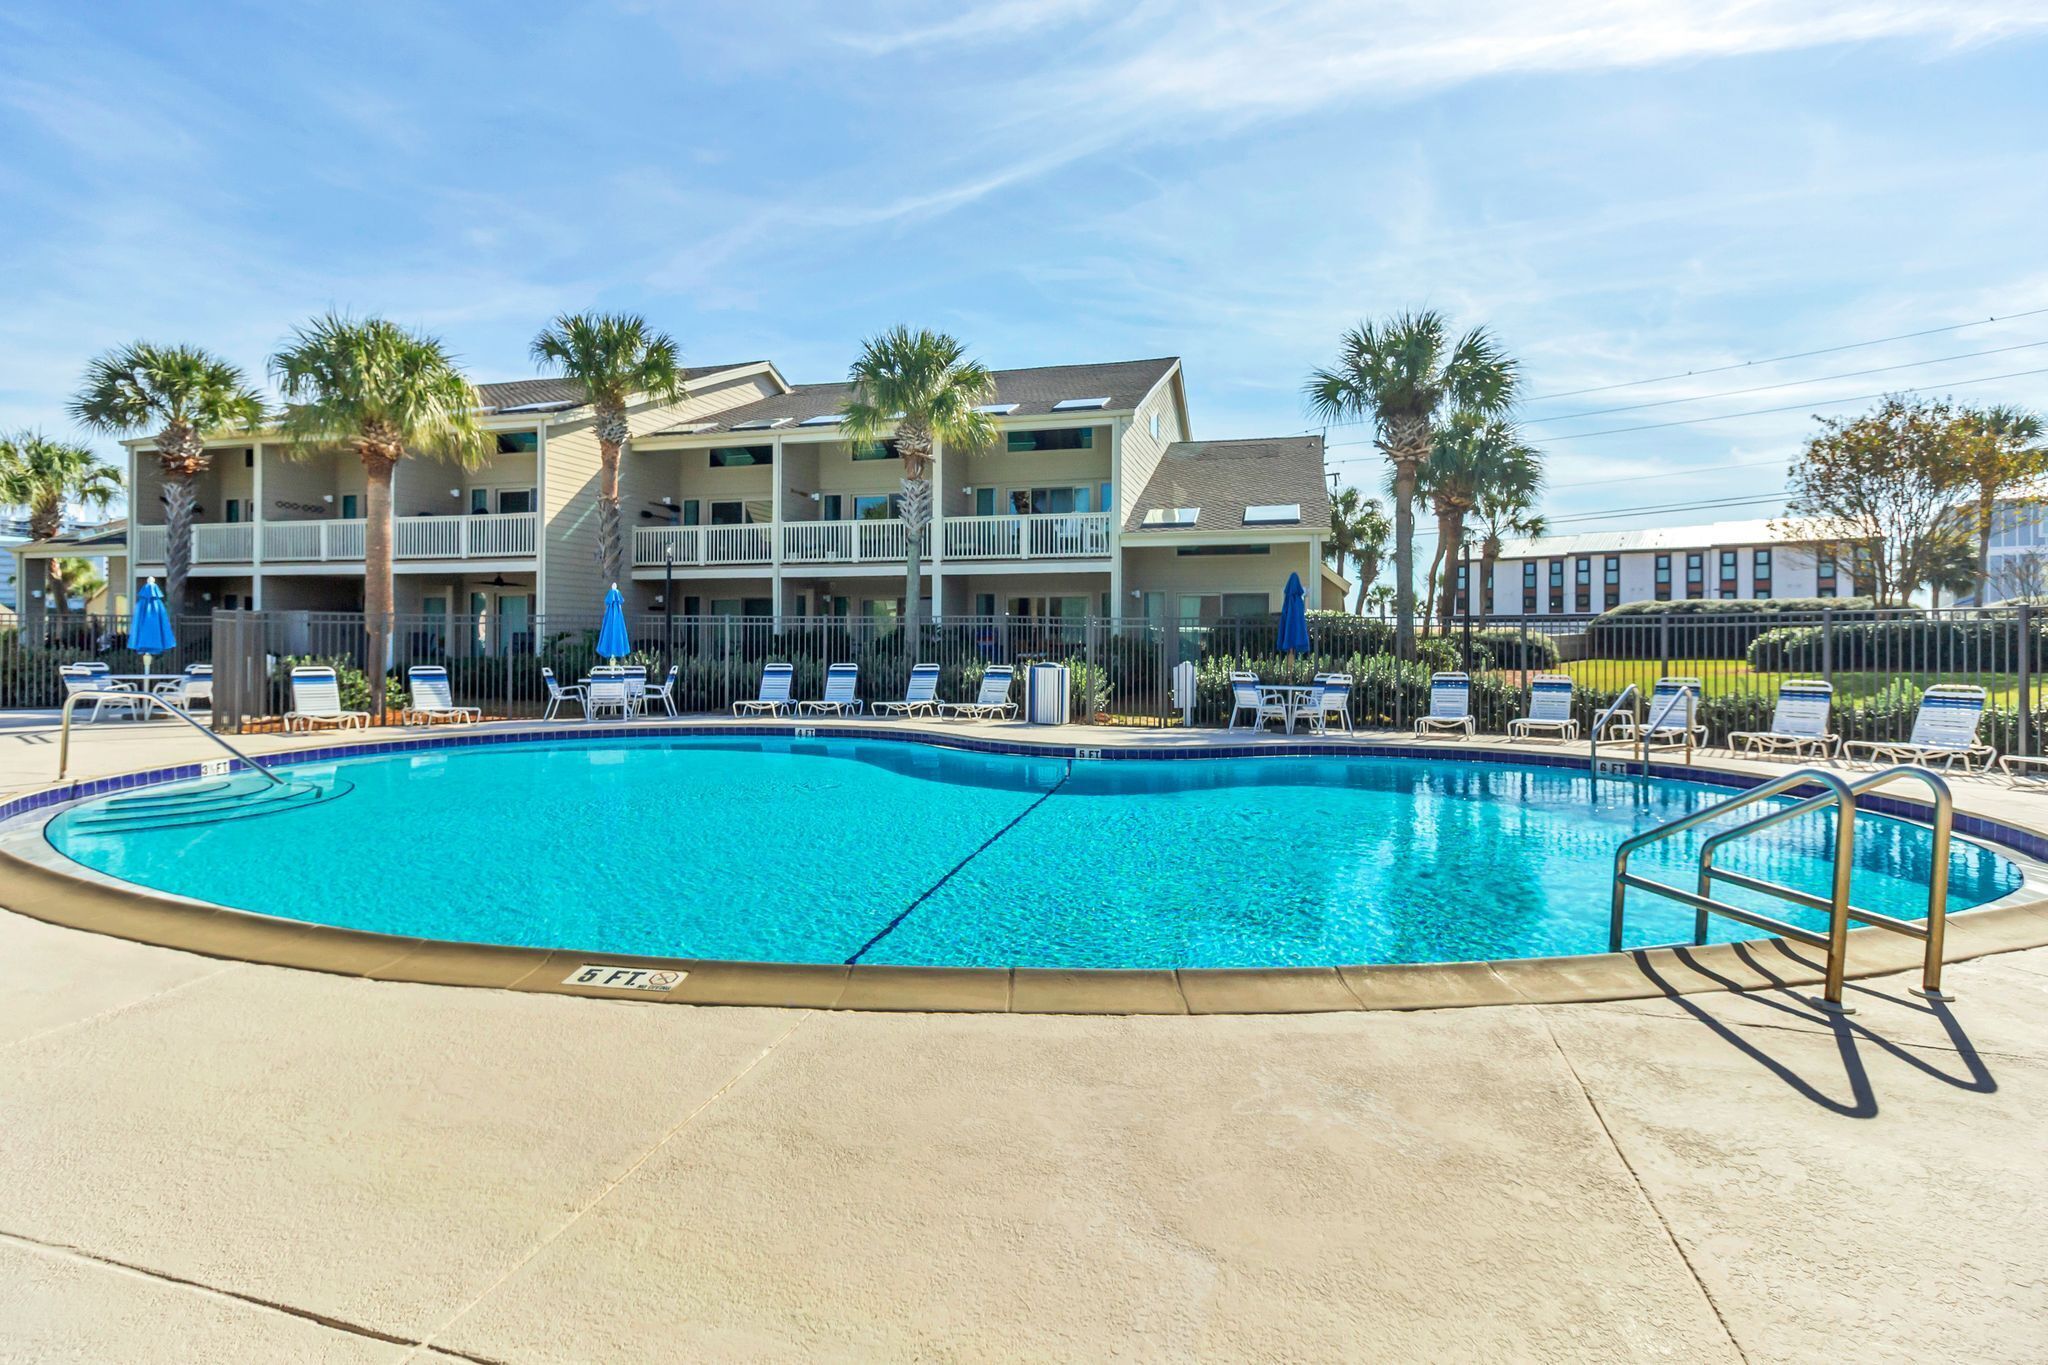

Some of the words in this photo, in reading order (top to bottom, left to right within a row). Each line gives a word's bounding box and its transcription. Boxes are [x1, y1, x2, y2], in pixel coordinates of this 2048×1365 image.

[805, 729, 815, 738] FT
[1079, 750, 1085, 758] 5
[1089, 750, 1100, 759] FT
[216, 761, 228, 774] FT
[1611, 763, 1625, 775] FT
[577, 968, 603, 983] 5
[603, 970, 648, 986] FT.
